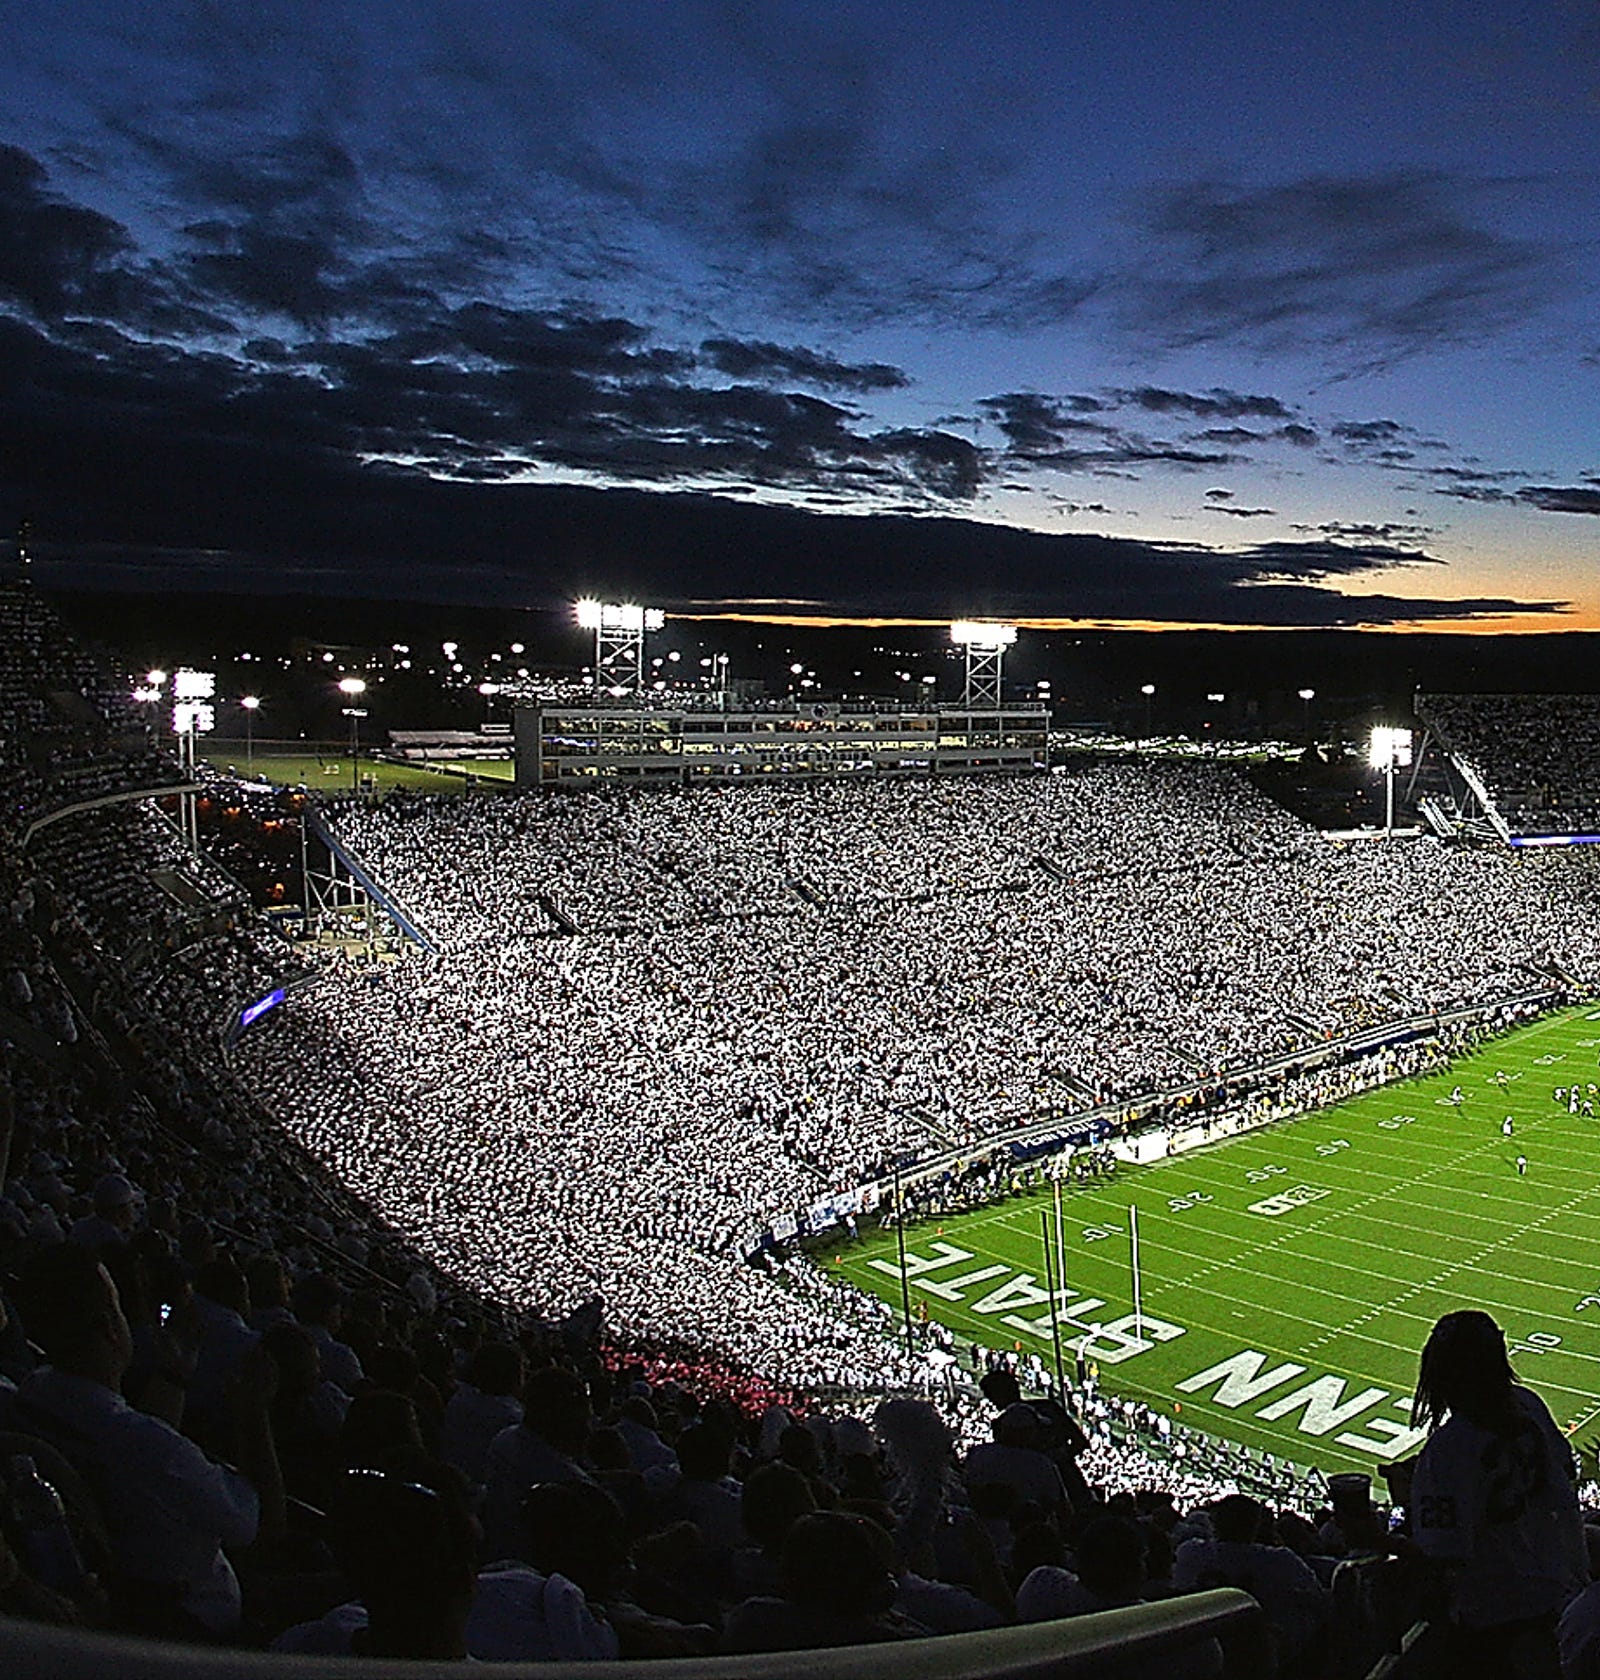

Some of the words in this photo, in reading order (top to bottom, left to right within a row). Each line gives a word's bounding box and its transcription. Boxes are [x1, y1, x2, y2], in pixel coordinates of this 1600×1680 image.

[1168, 1191, 1213, 1210] 20
[1513, 1331, 1562, 1355] 10
[1174, 1350, 1430, 1460] ENN
